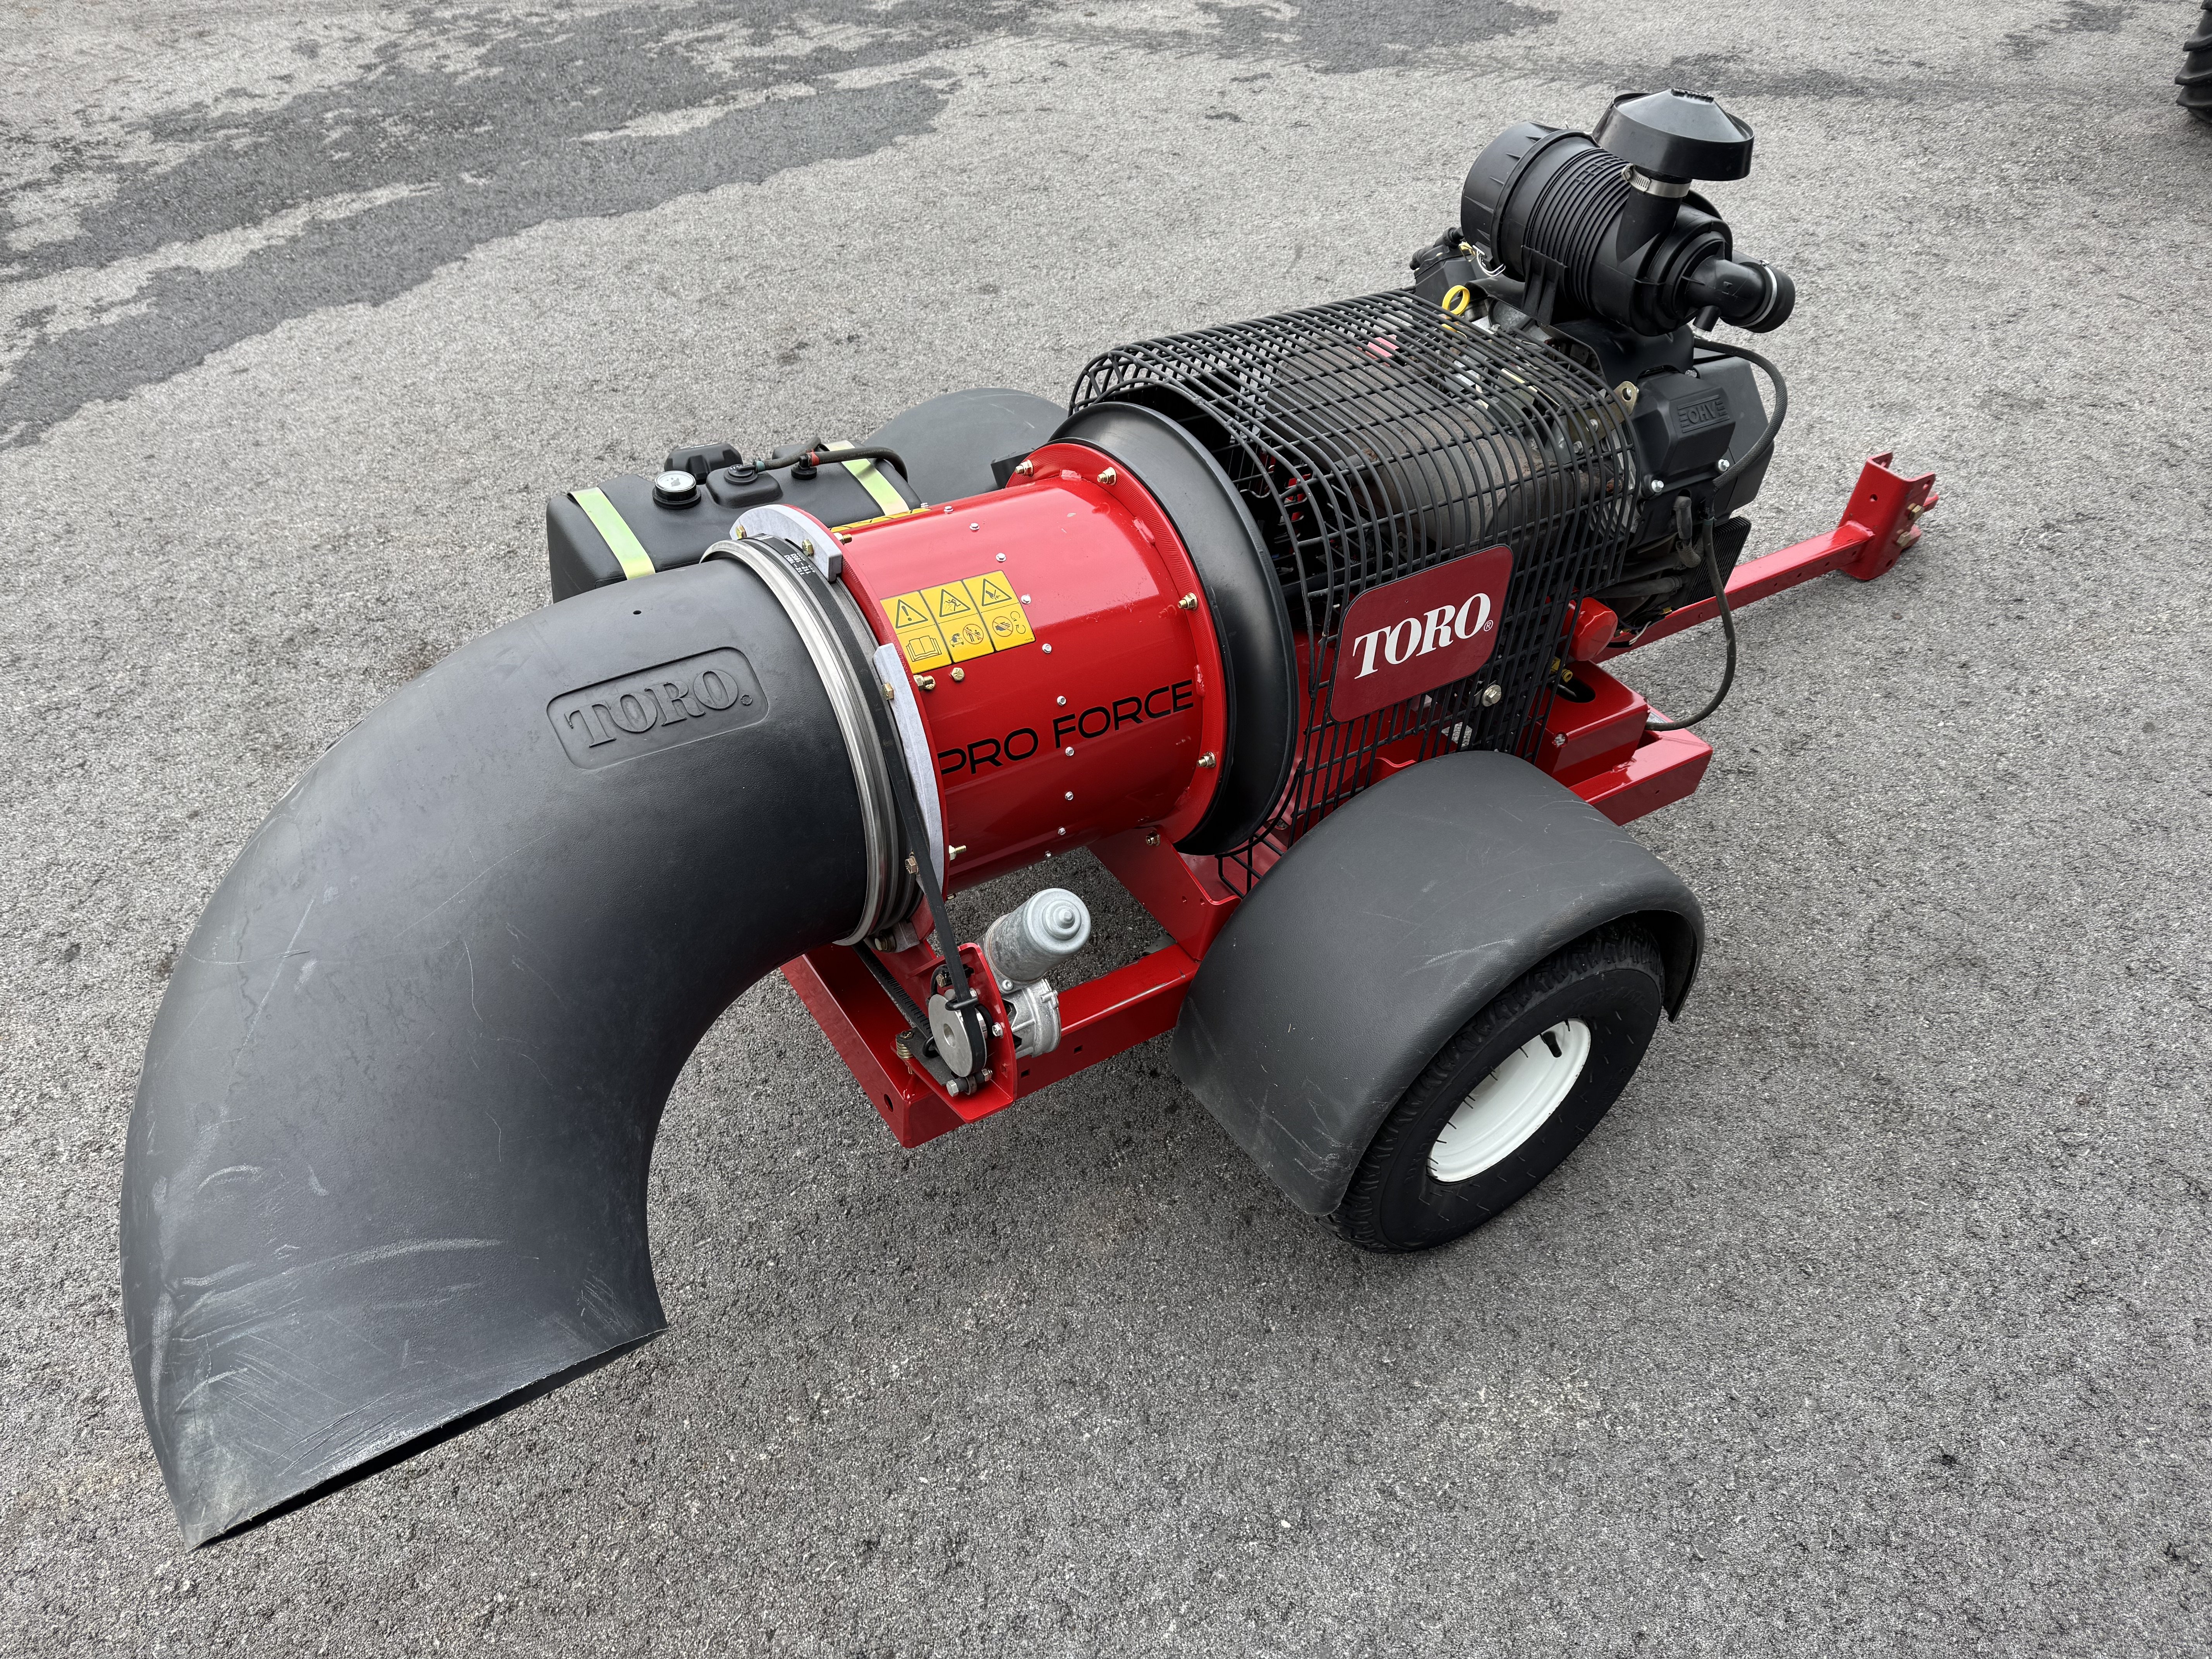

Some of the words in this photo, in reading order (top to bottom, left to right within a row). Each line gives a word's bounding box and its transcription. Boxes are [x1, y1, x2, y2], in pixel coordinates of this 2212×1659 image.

[1687, 402, 1717, 424] OHV
[937, 727, 1039, 775] PRO
[1053, 679, 1194, 749] FORCE
